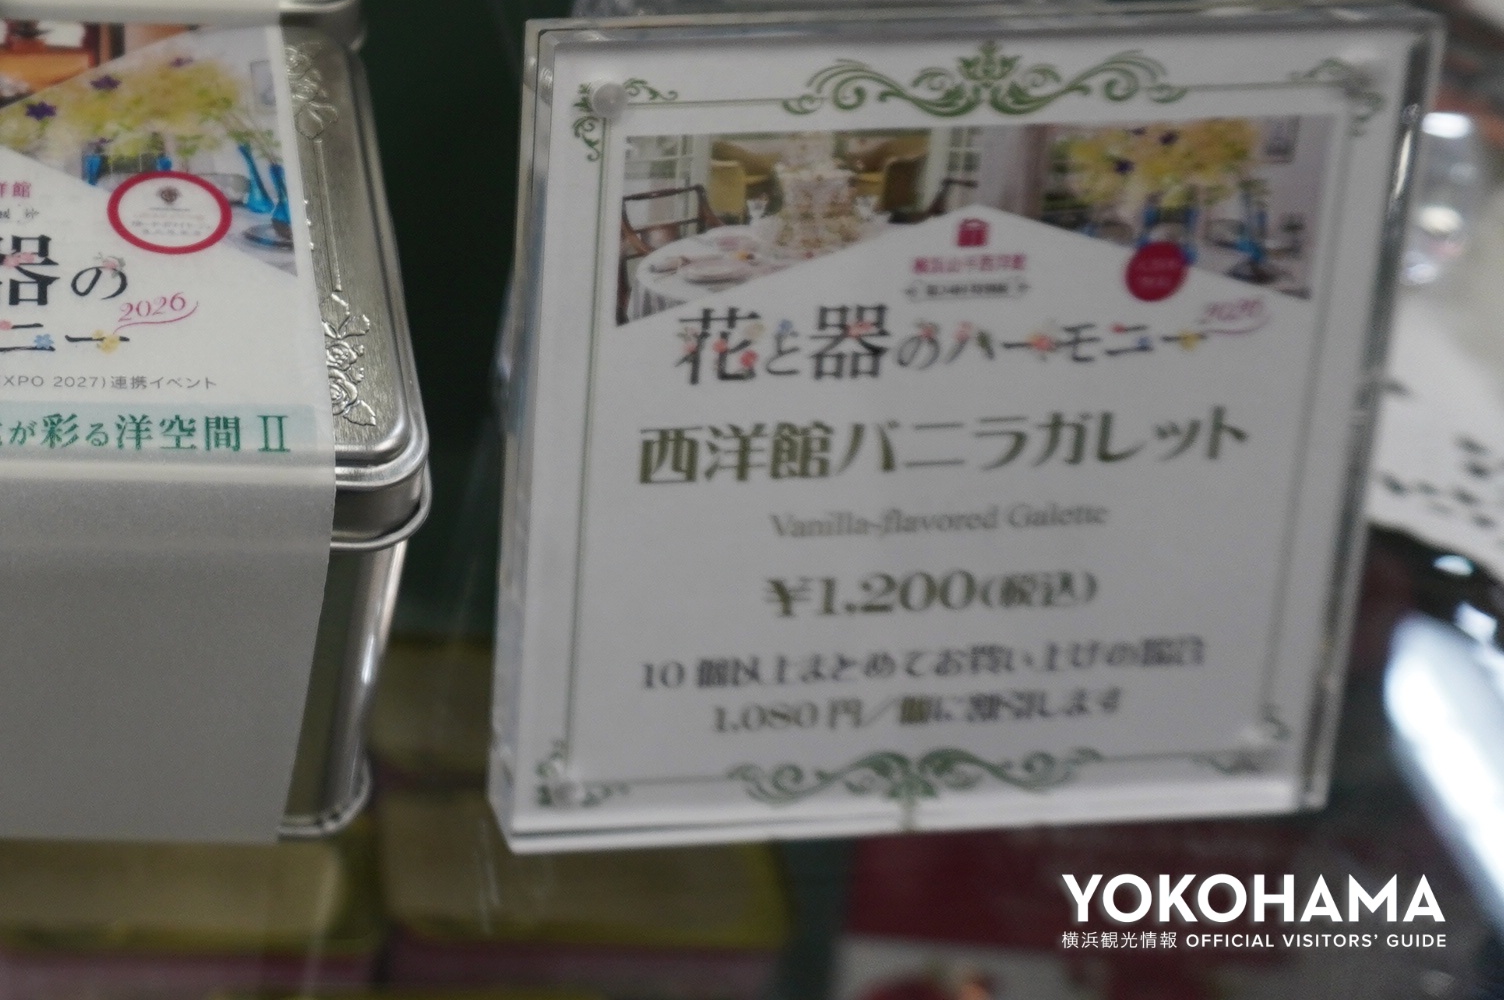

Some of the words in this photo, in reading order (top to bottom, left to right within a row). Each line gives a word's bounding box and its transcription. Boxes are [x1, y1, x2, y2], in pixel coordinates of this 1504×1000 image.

[117, 291, 187, 322] 2026
[676, 302, 1207, 386] 花と器のハーモニー
[638, 396, 1250, 485] 西洋館バニラガレット
